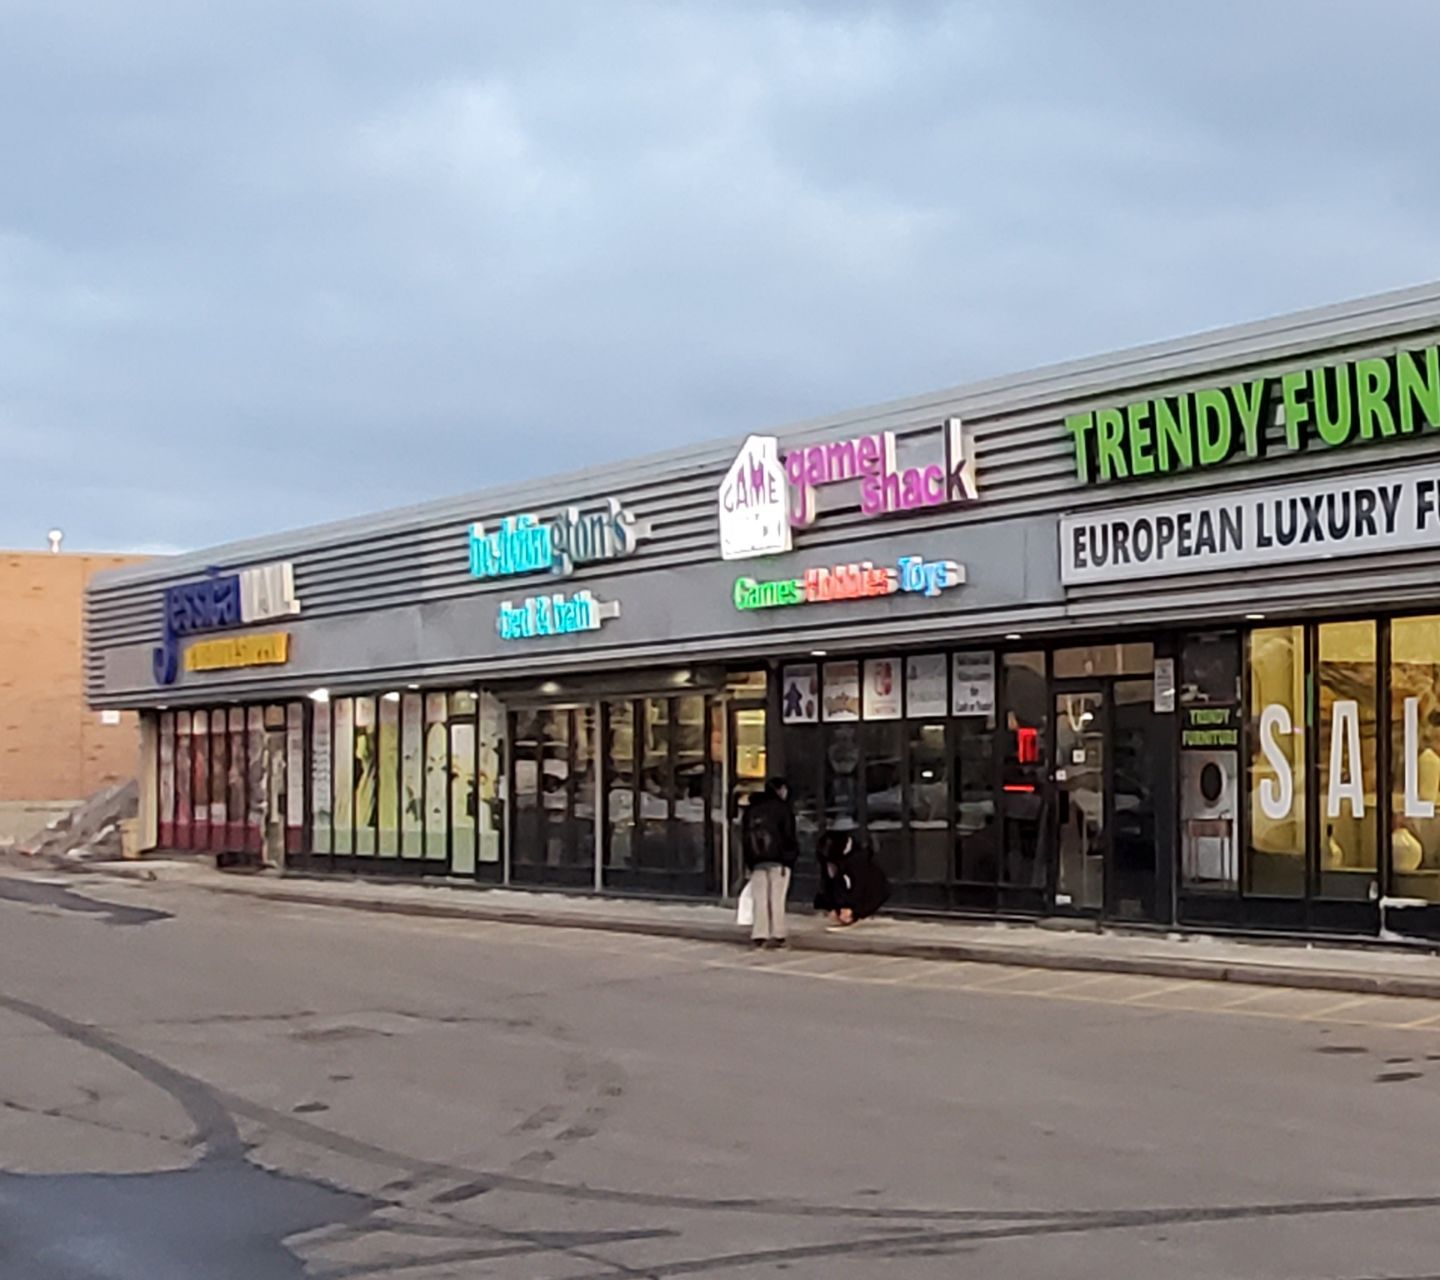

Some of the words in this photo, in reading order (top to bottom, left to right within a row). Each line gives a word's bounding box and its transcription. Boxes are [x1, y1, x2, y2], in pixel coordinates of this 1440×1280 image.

[860, 418, 979, 516] shack
[1065, 378, 1265, 484] TRENDY
[785, 434, 880, 528] game
[1072, 505, 1244, 569] EUROPEAN
[1255, 484, 1403, 549] LUXURY
[734, 576, 803, 610] Games
[804, 562, 897, 602] Hobbies
[898, 556, 958, 597] Toys
